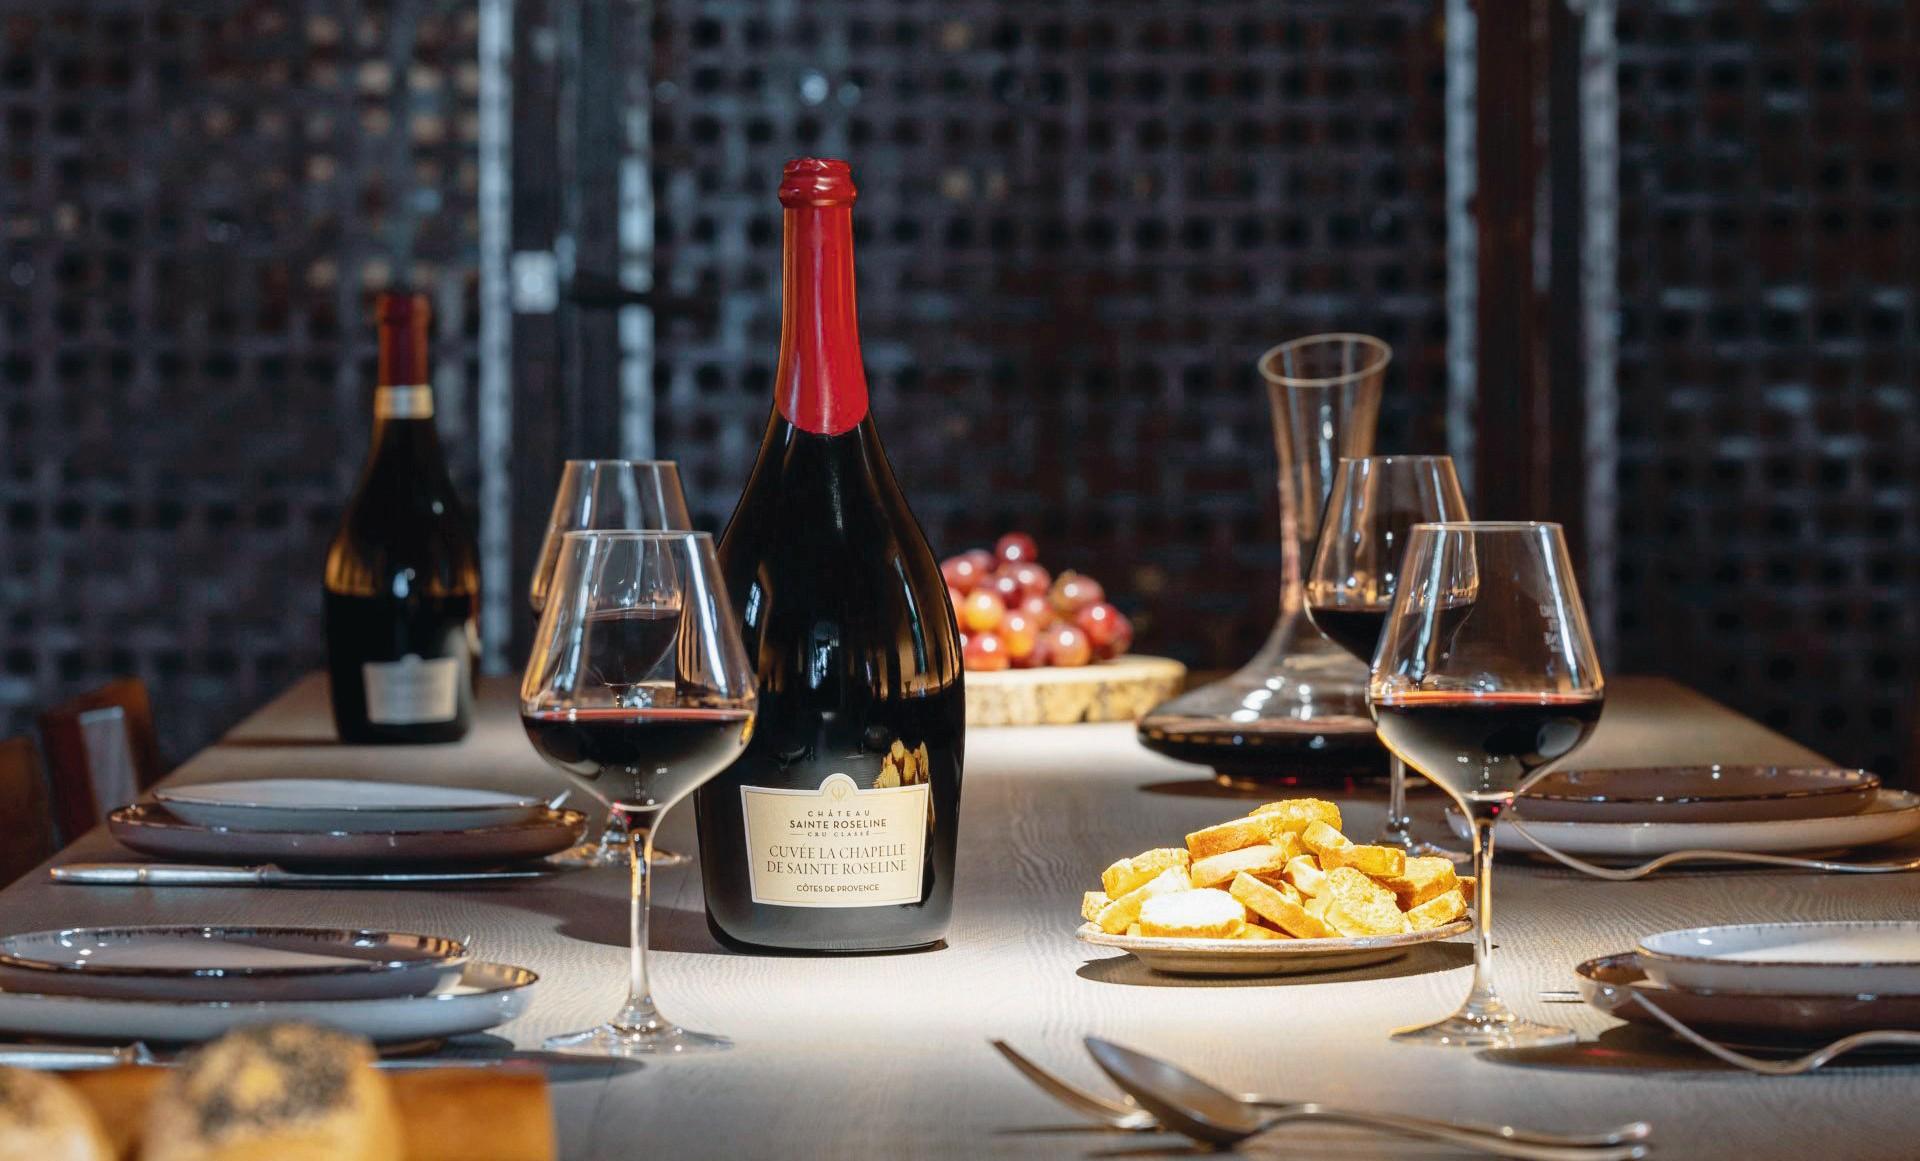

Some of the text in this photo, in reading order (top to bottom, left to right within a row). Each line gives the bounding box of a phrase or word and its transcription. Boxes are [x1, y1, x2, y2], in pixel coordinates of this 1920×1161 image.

[807, 808, 870, 817] CHÂTEAU
[789, 818, 887, 829] SAINTE ROSELINE
[769, 843, 906, 859] CUVÉE LA CHAPELLE
[767, 859, 907, 875] DE SAINTE ROSELINE
[796, 882, 823, 892] CÔTES
[837, 883, 880, 892] PROVENCE
